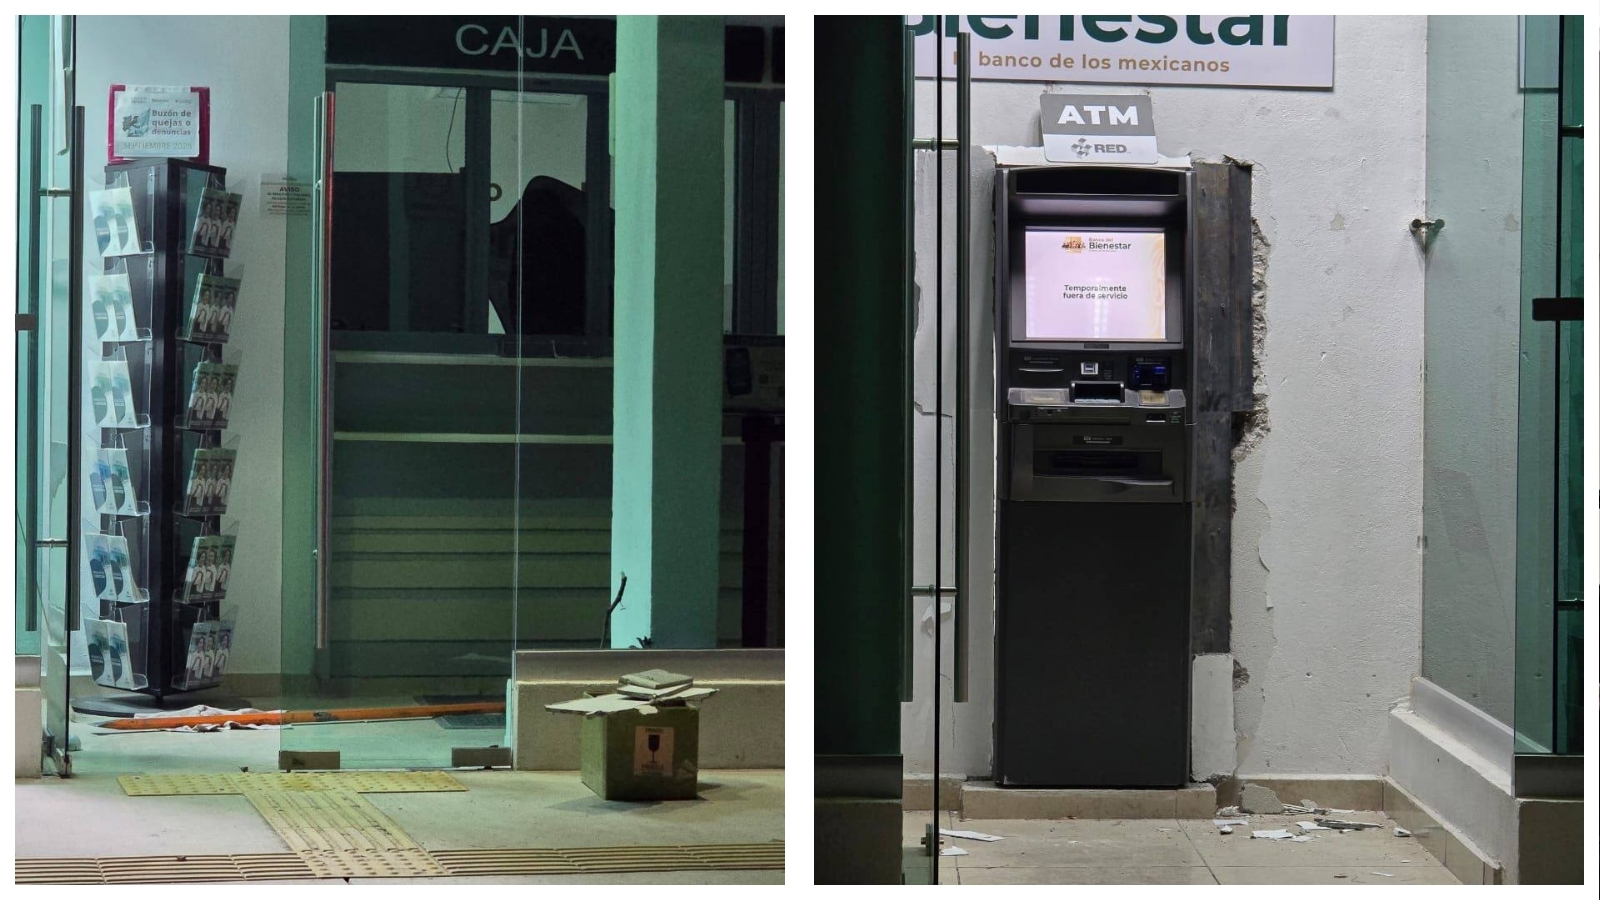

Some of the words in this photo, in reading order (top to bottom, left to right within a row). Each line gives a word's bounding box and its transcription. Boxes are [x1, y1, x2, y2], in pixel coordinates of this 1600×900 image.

[455, 24, 585, 60] CAJA
[978, 51, 1042, 67] banco
[1050, 53, 1074, 69] de
[1082, 54, 1111, 70] los
[1118, 55, 1230, 73] mexicanos
[152, 119, 182, 127] quejas
[1057, 104, 1139, 126] ATM
[1094, 143, 1128, 154] RED
[1089, 242, 1131, 250] Bienestar
